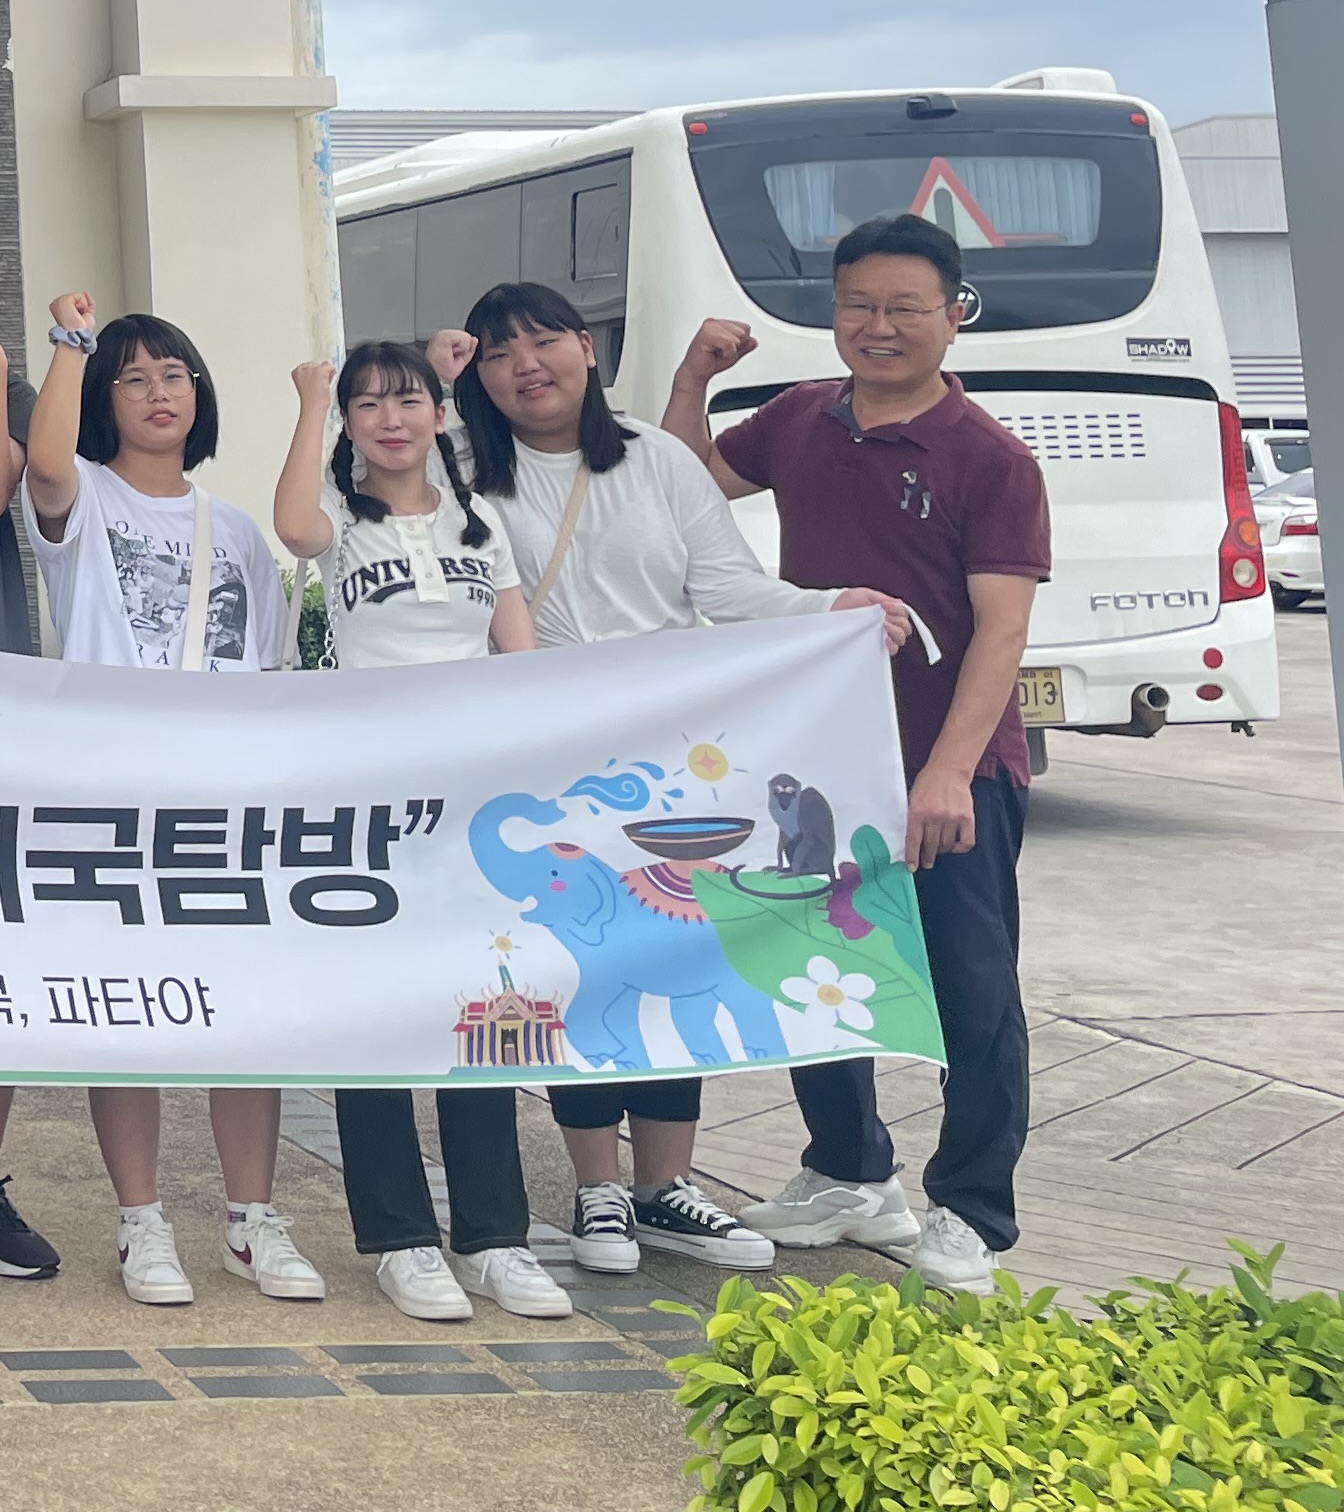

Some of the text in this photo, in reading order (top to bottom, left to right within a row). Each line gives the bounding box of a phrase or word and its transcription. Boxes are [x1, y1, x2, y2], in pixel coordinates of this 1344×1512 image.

[165, 540, 228, 559] MID
[341, 557, 493, 613] UNIVRSE
[41, 976, 216, 1028] 파타야
